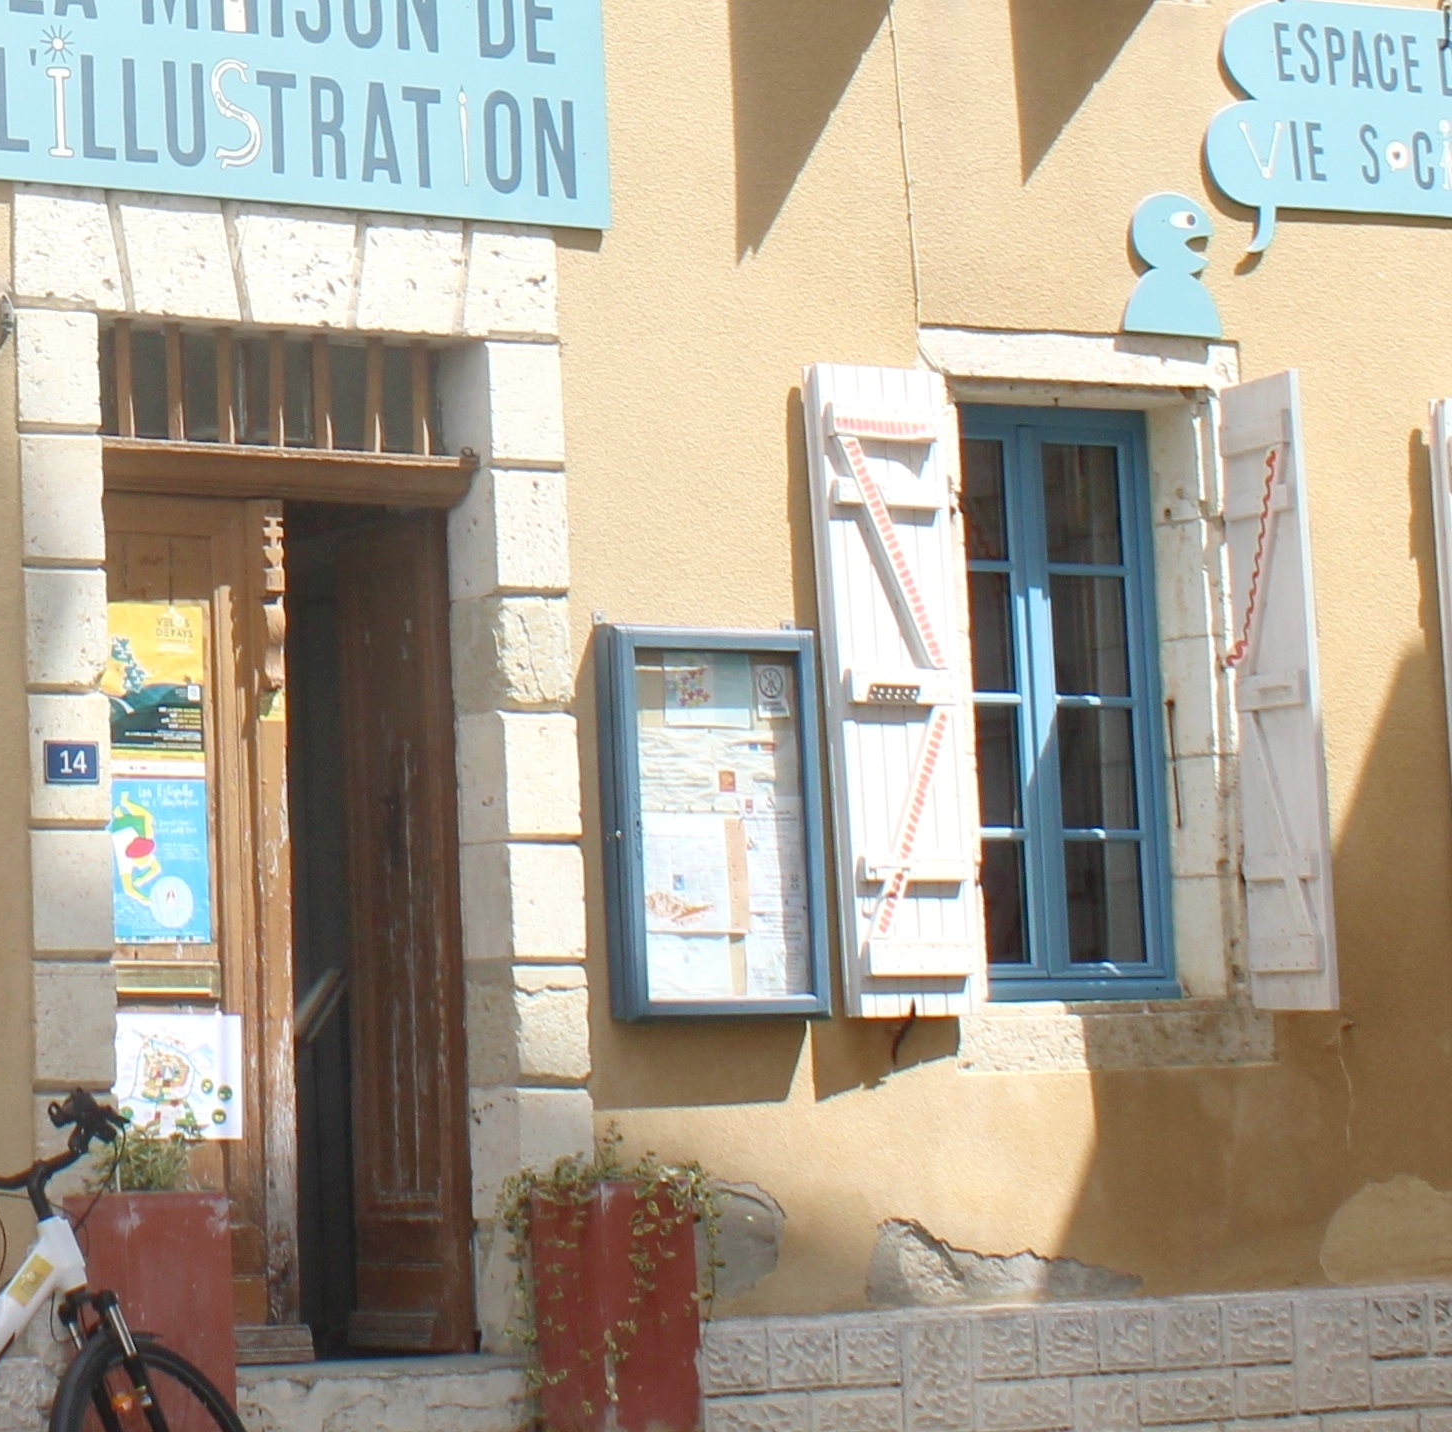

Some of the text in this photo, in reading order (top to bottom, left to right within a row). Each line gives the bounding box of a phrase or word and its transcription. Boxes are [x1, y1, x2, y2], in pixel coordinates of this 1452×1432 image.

[1273, 22, 1422, 93] ESPACE
[1238, 120, 1327, 182] VIE
[59, 750, 88, 774] 14
